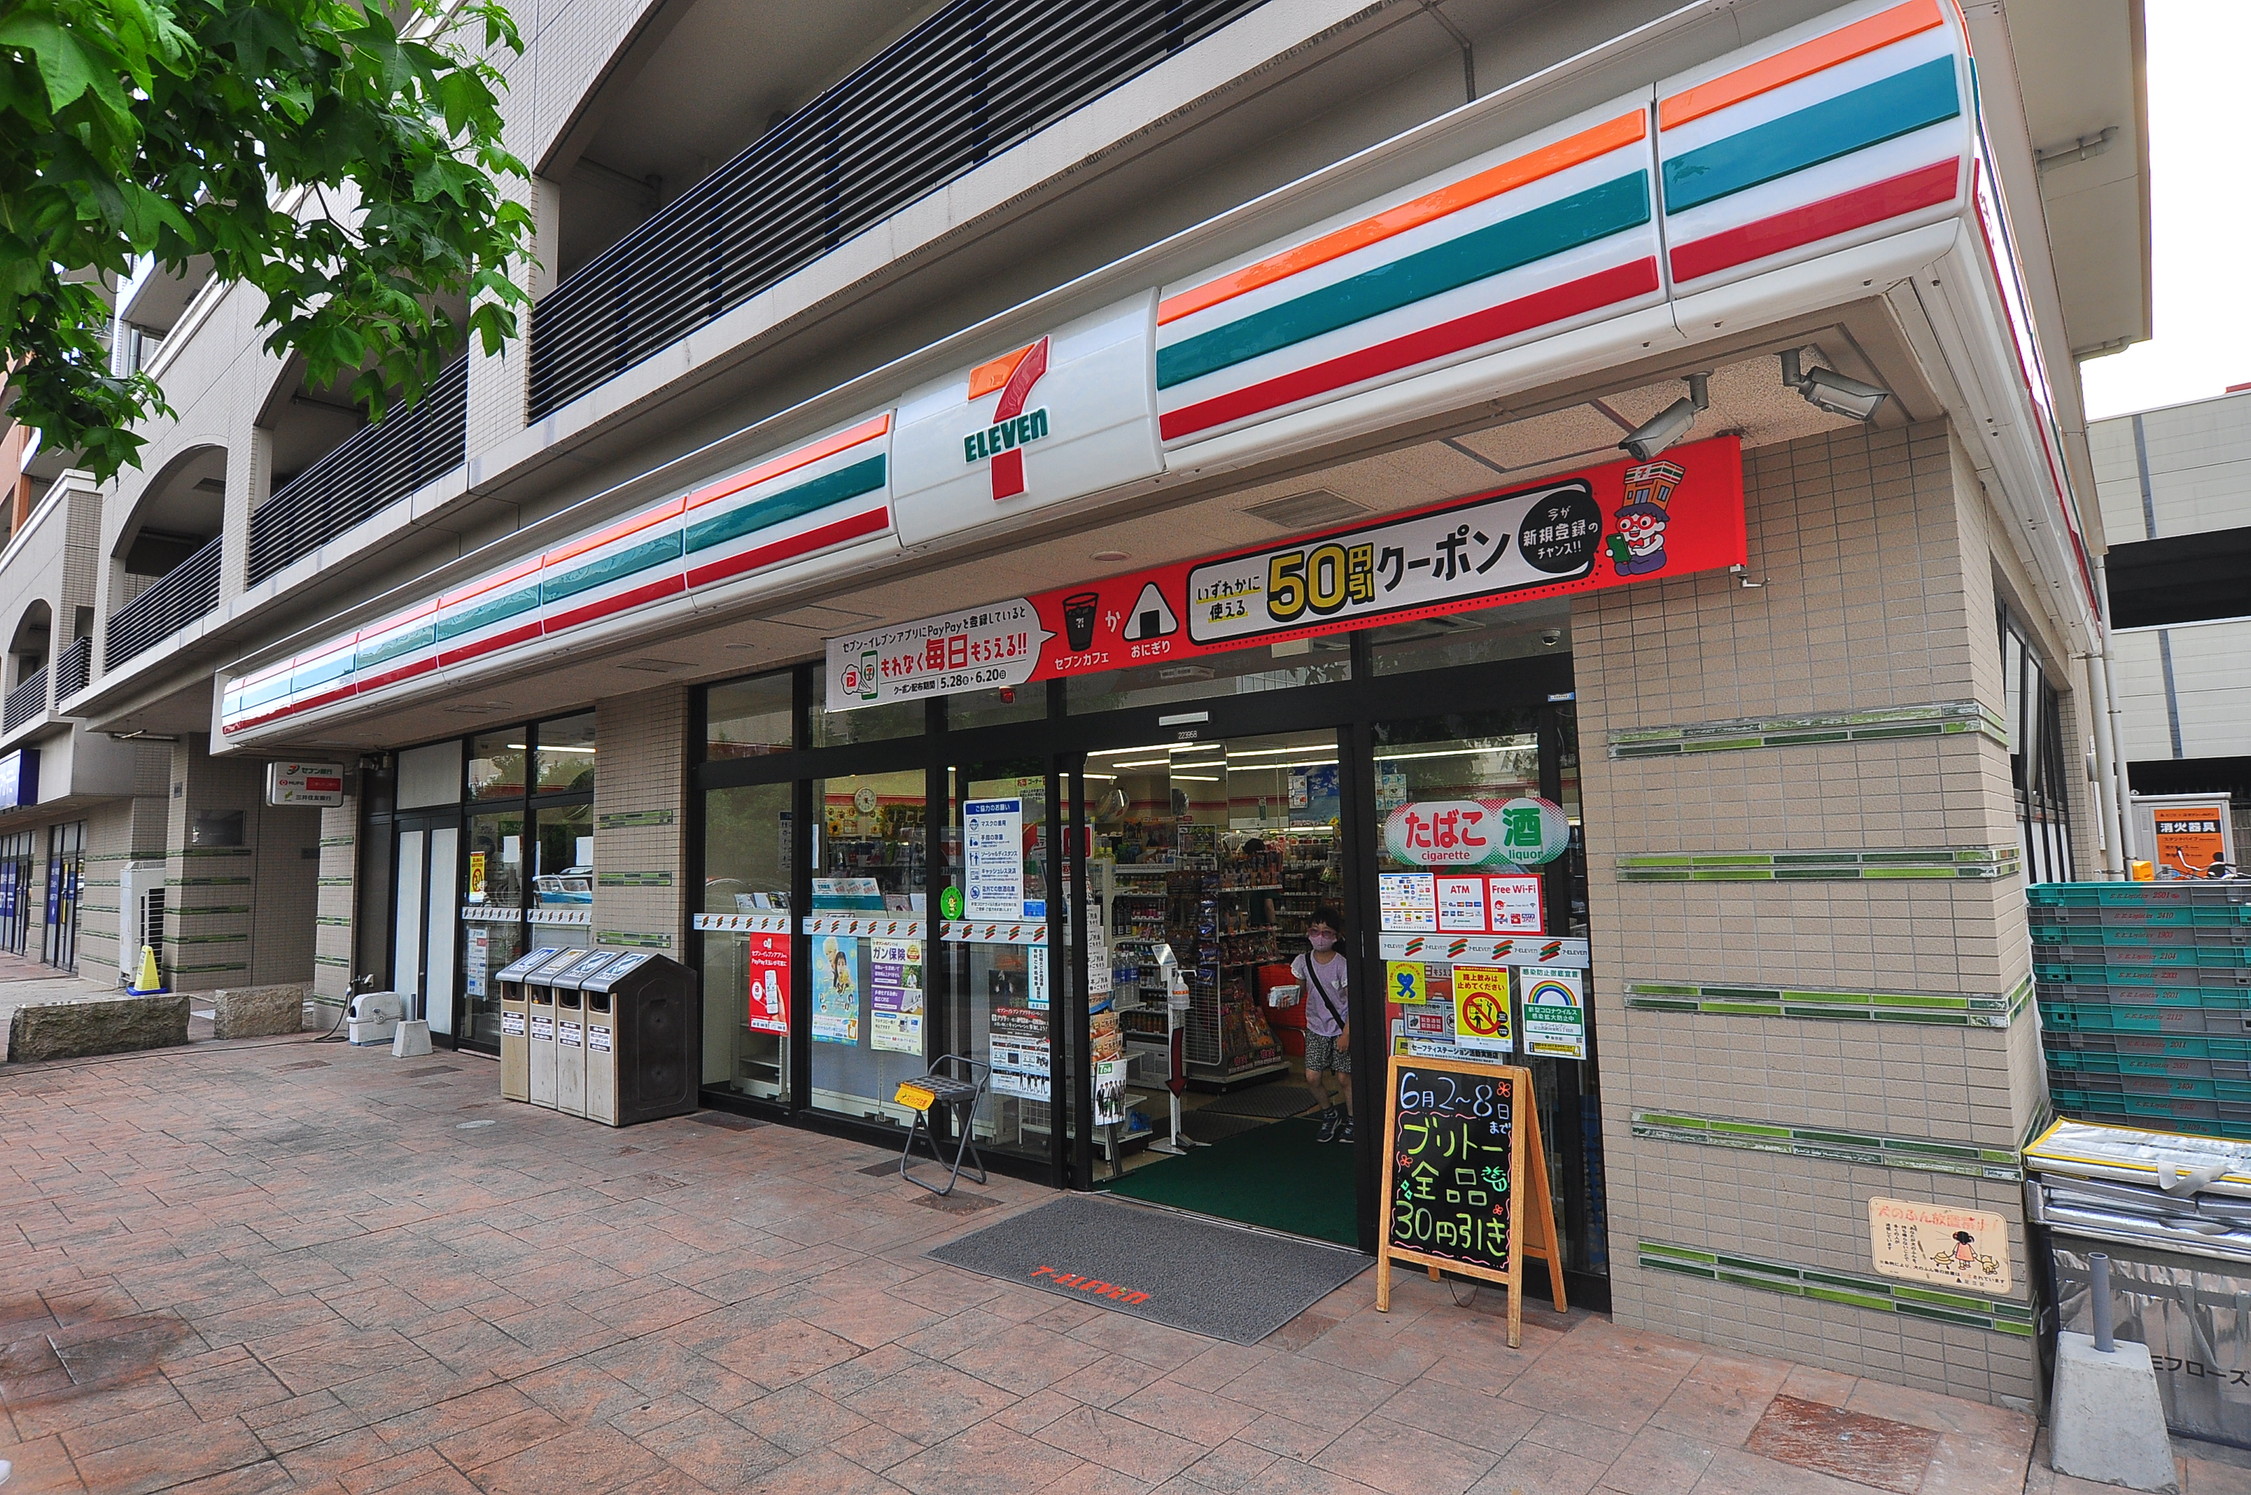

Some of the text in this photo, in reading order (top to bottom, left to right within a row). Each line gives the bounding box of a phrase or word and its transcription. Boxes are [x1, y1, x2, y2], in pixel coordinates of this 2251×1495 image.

[1548, 505, 1571, 522] 今が
[1522, 519, 1599, 547] 新規登録の
[1197, 575, 1261, 601] いずれかに
[1209, 600, 1246, 620] 使える
[1105, 610, 1121, 633] か
[1130, 640, 1171, 659] おにぎり
[1054, 652, 1110, 671] セブンカフェ
[1404, 808, 1487, 849] たばこ
[1502, 807, 1542, 848] 酒
[2160, 821, 2216, 833] 消火器具
[1421, 850, 1470, 862] cigarette
[1508, 849, 1543, 861] liquor
[1450, 885, 1470, 894] ATM
[1492, 884, 1537, 894] Free Wi-Fi
[873, 946, 906, 961] ガン保険
[1457, 982, 1505, 991] 止めてください
[1527, 1006, 1578, 1016] 新型コロナウイルス
[1489, 1120, 1512, 1135] まで
[1403, 1116, 1504, 1161] ブリトー
[1410, 1160, 1488, 1207] 全品
[1395, 1200, 1507, 1257] 30円引き
